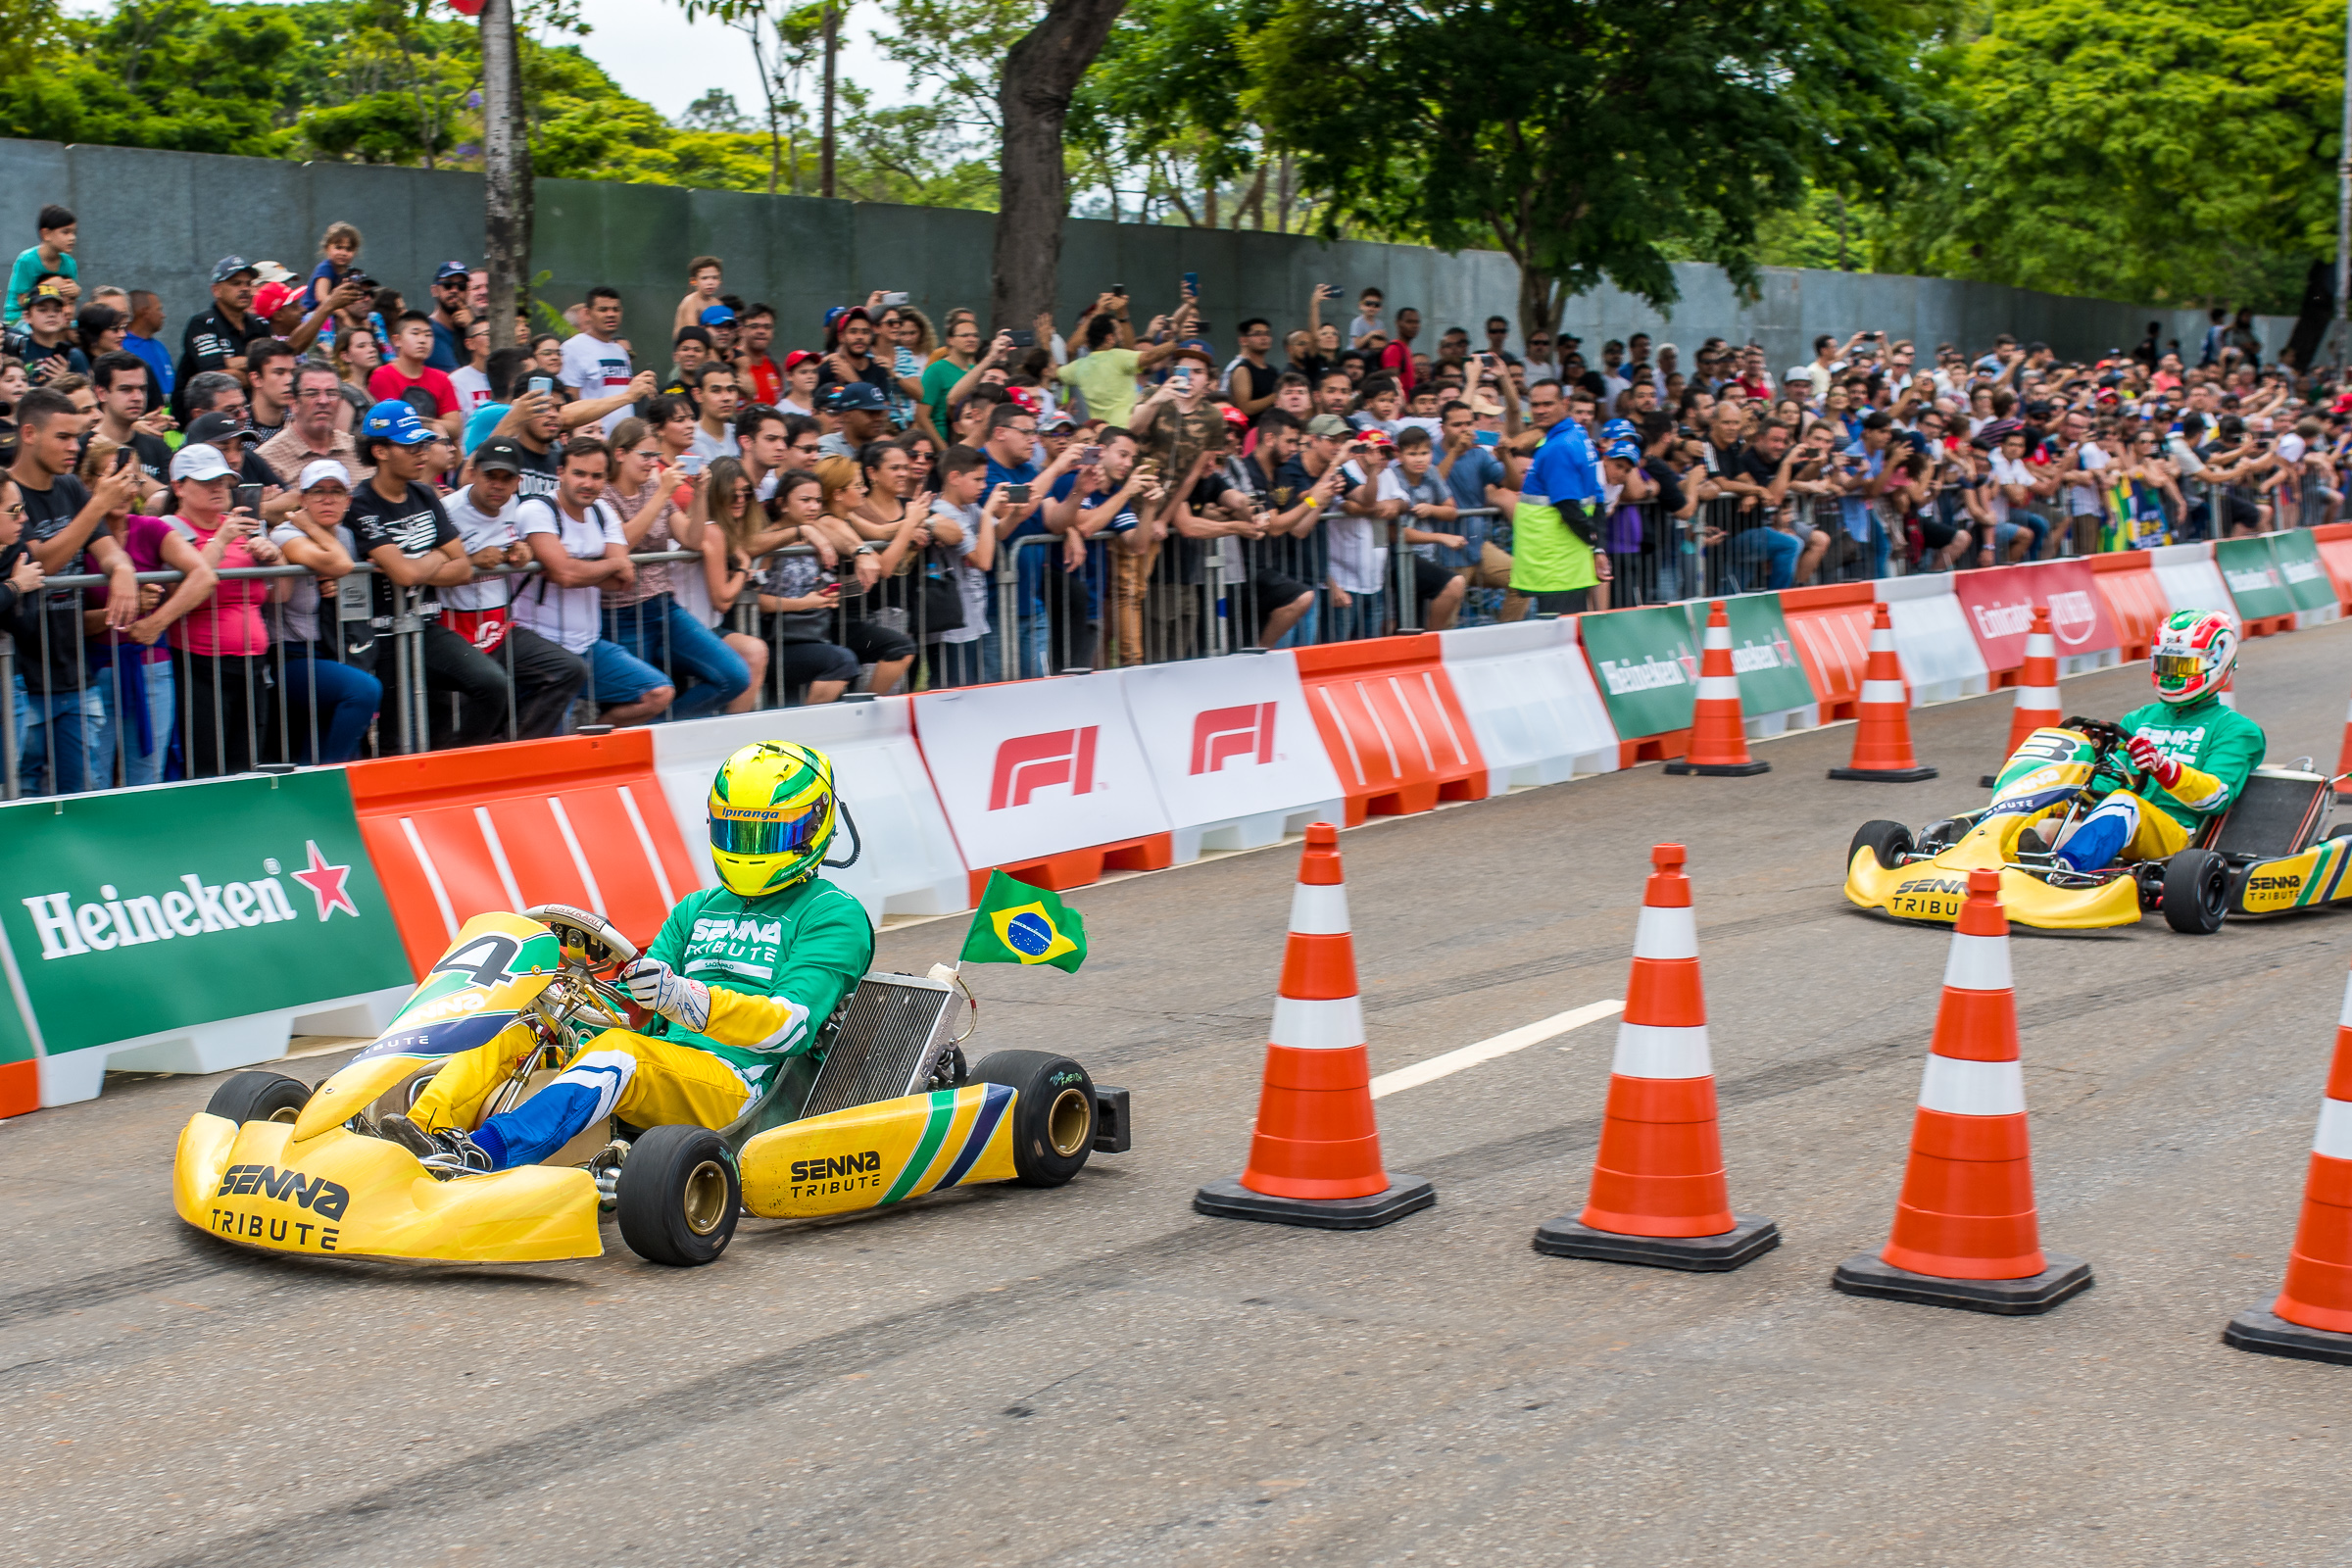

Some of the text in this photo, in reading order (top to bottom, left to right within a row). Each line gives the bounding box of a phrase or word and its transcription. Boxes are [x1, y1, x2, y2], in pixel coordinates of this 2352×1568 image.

[1732, 640, 1782, 673] neken
[1189, 701, 1279, 776] F1
[2013, 734, 2077, 762] 3
[987, 724, 1101, 811] F1
[1895, 878, 1971, 898] SENN
[2249, 875, 2300, 890] SENNA
[2249, 890, 2300, 901] TRIBUTE
[22, 873, 297, 960] Heineken
[1892, 897, 1958, 915] TRIBU
[691, 918, 781, 946] SENNA
[432, 935, 517, 988] 4
[684, 940, 777, 962] TRIBUTE
[352, 1035, 429, 1060] RIBUTE
[790, 1151, 881, 1183] SENNA
[217, 1164, 350, 1222] SENNA
[790, 1173, 881, 1199] TRIBUTE
[212, 1208, 340, 1250] TRIBUTE
